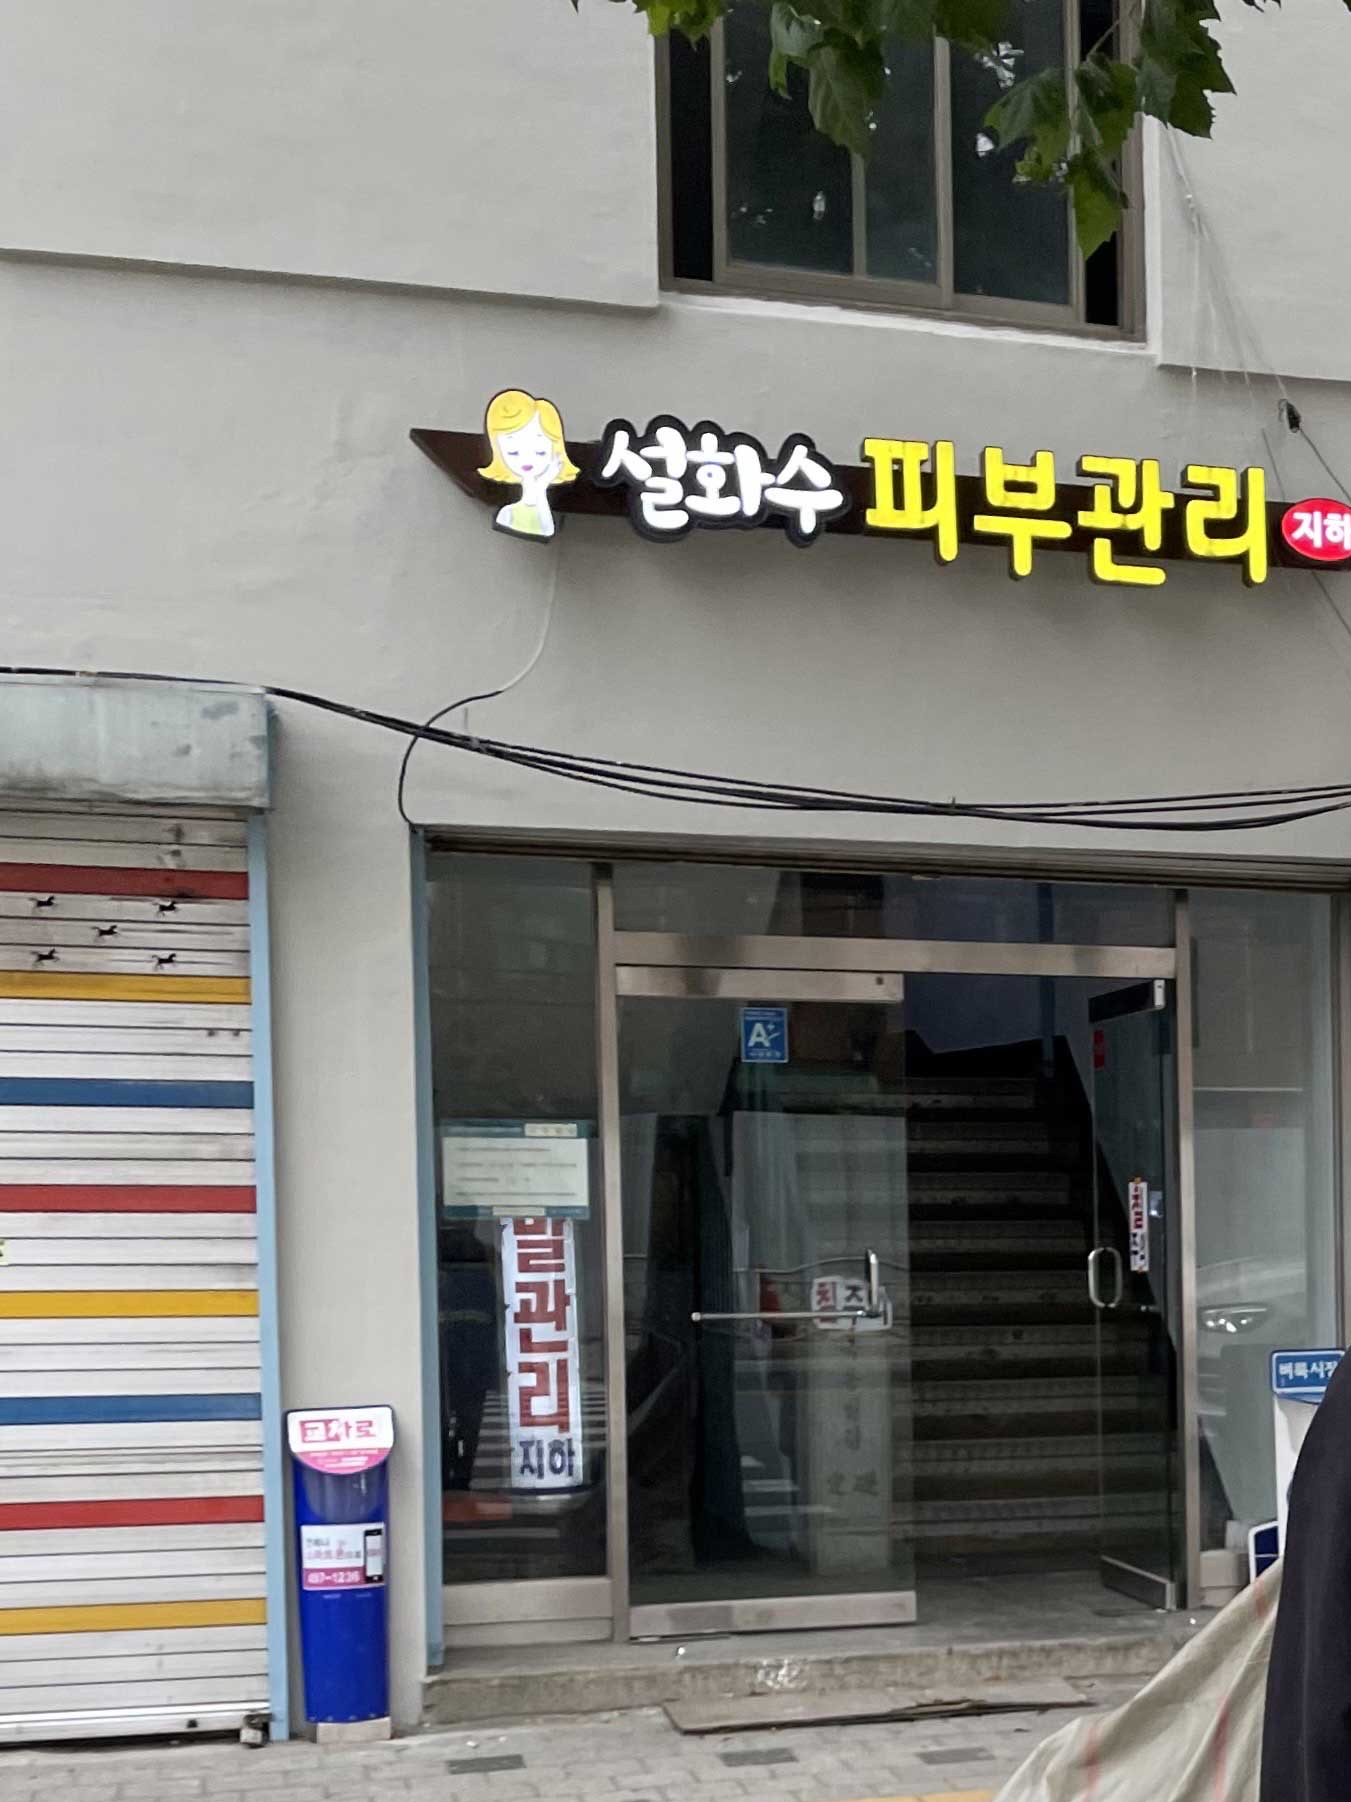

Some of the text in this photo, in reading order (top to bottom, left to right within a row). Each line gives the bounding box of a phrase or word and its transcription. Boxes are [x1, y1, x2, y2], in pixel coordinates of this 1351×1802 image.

[601, 425, 843, 532] 설화수
[862, 437, 1268, 585] 피부관리
[300, 1418, 377, 1443] 교차로
[518, 1437, 576, 1480] 지하
